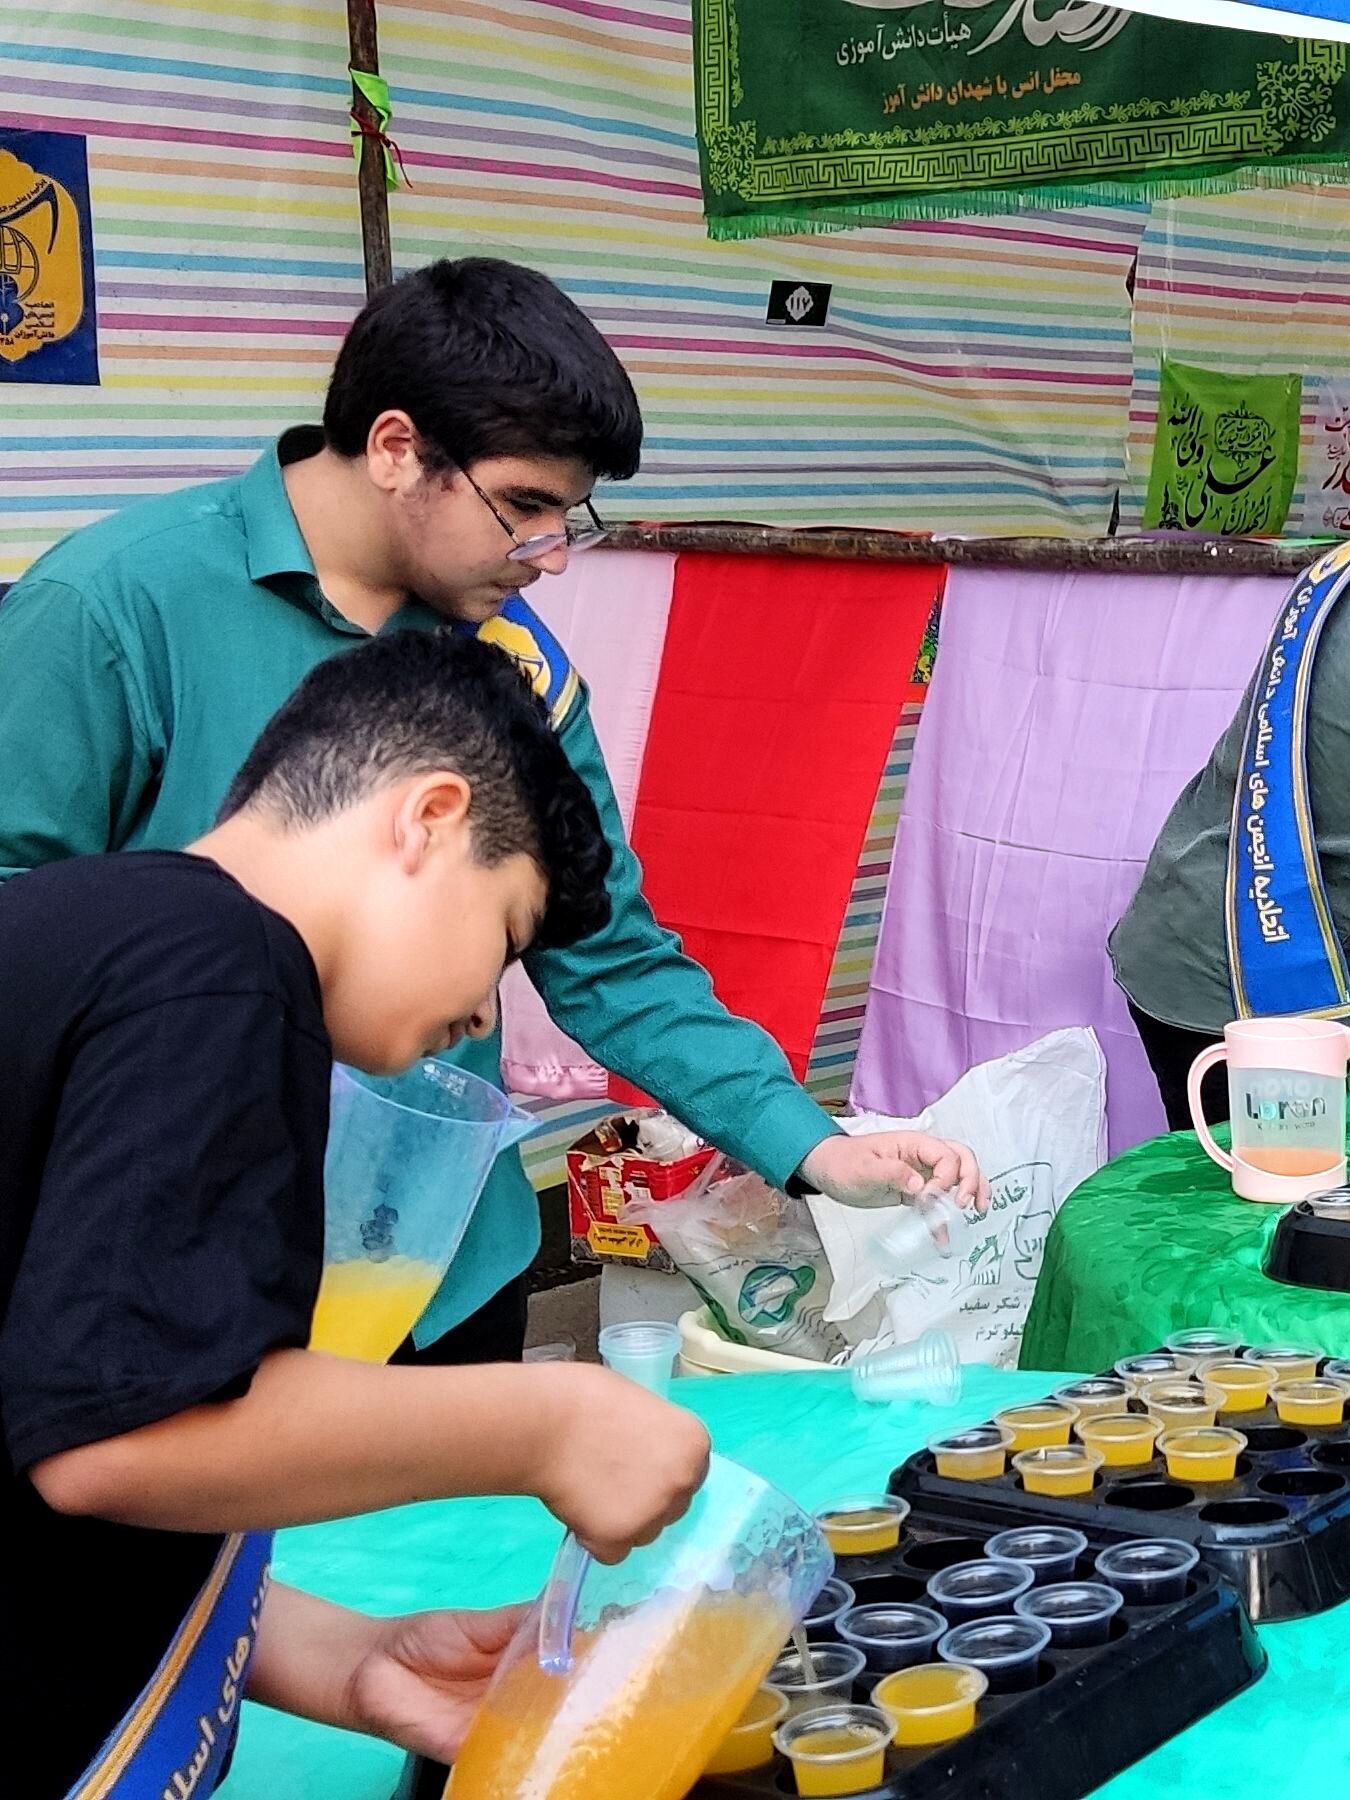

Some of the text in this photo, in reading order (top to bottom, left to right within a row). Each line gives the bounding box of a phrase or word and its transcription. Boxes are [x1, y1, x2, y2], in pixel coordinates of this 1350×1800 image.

[883, 67, 1082, 114] محفل انس با شهدای دانش آموز
[1247, 585, 1313, 942] اتحادیه انجمن های اسلامی دانش آموزان
[959, 1297, 1021, 1314] شکر سفید
[219, 1636, 249, 1723] های
